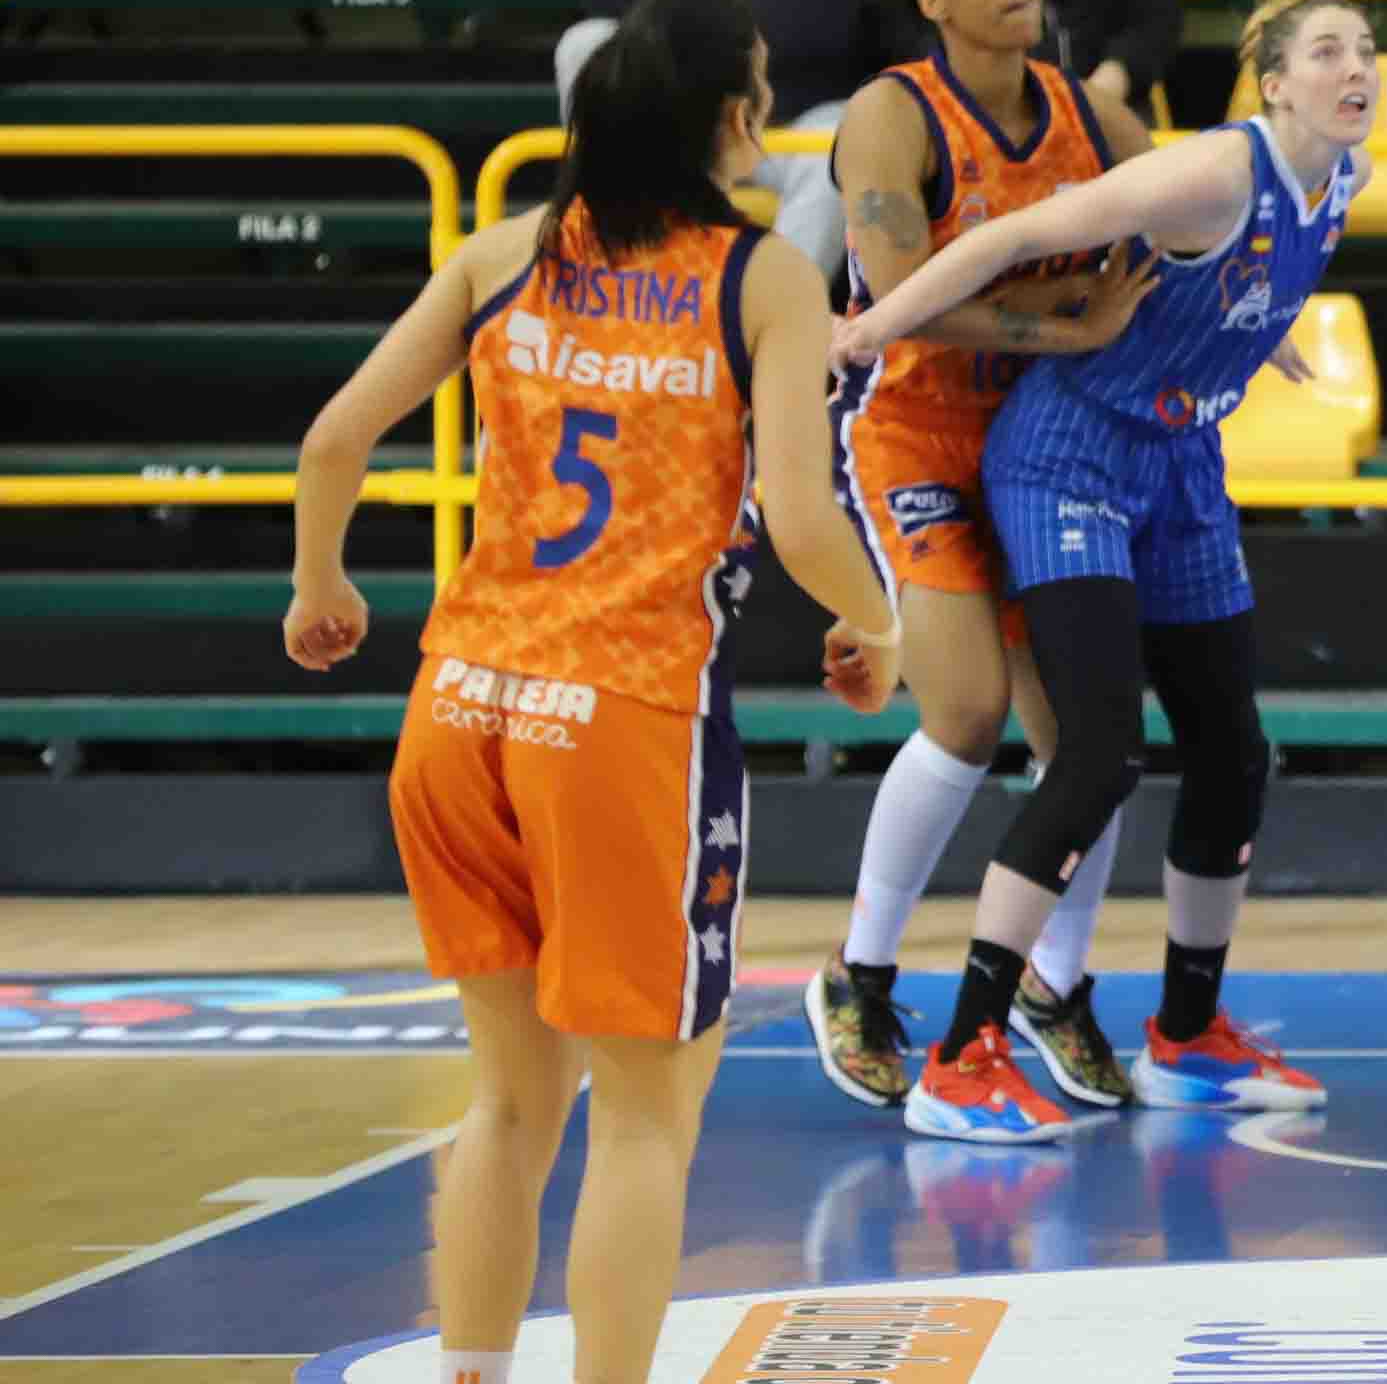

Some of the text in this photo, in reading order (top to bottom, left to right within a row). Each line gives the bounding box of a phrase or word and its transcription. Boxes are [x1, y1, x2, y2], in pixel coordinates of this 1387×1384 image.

[238, 215, 298, 241] FILA
[548, 260, 706, 322] RISTINA
[553, 333, 720, 400] isaval
[531, 406, 619, 570] 5
